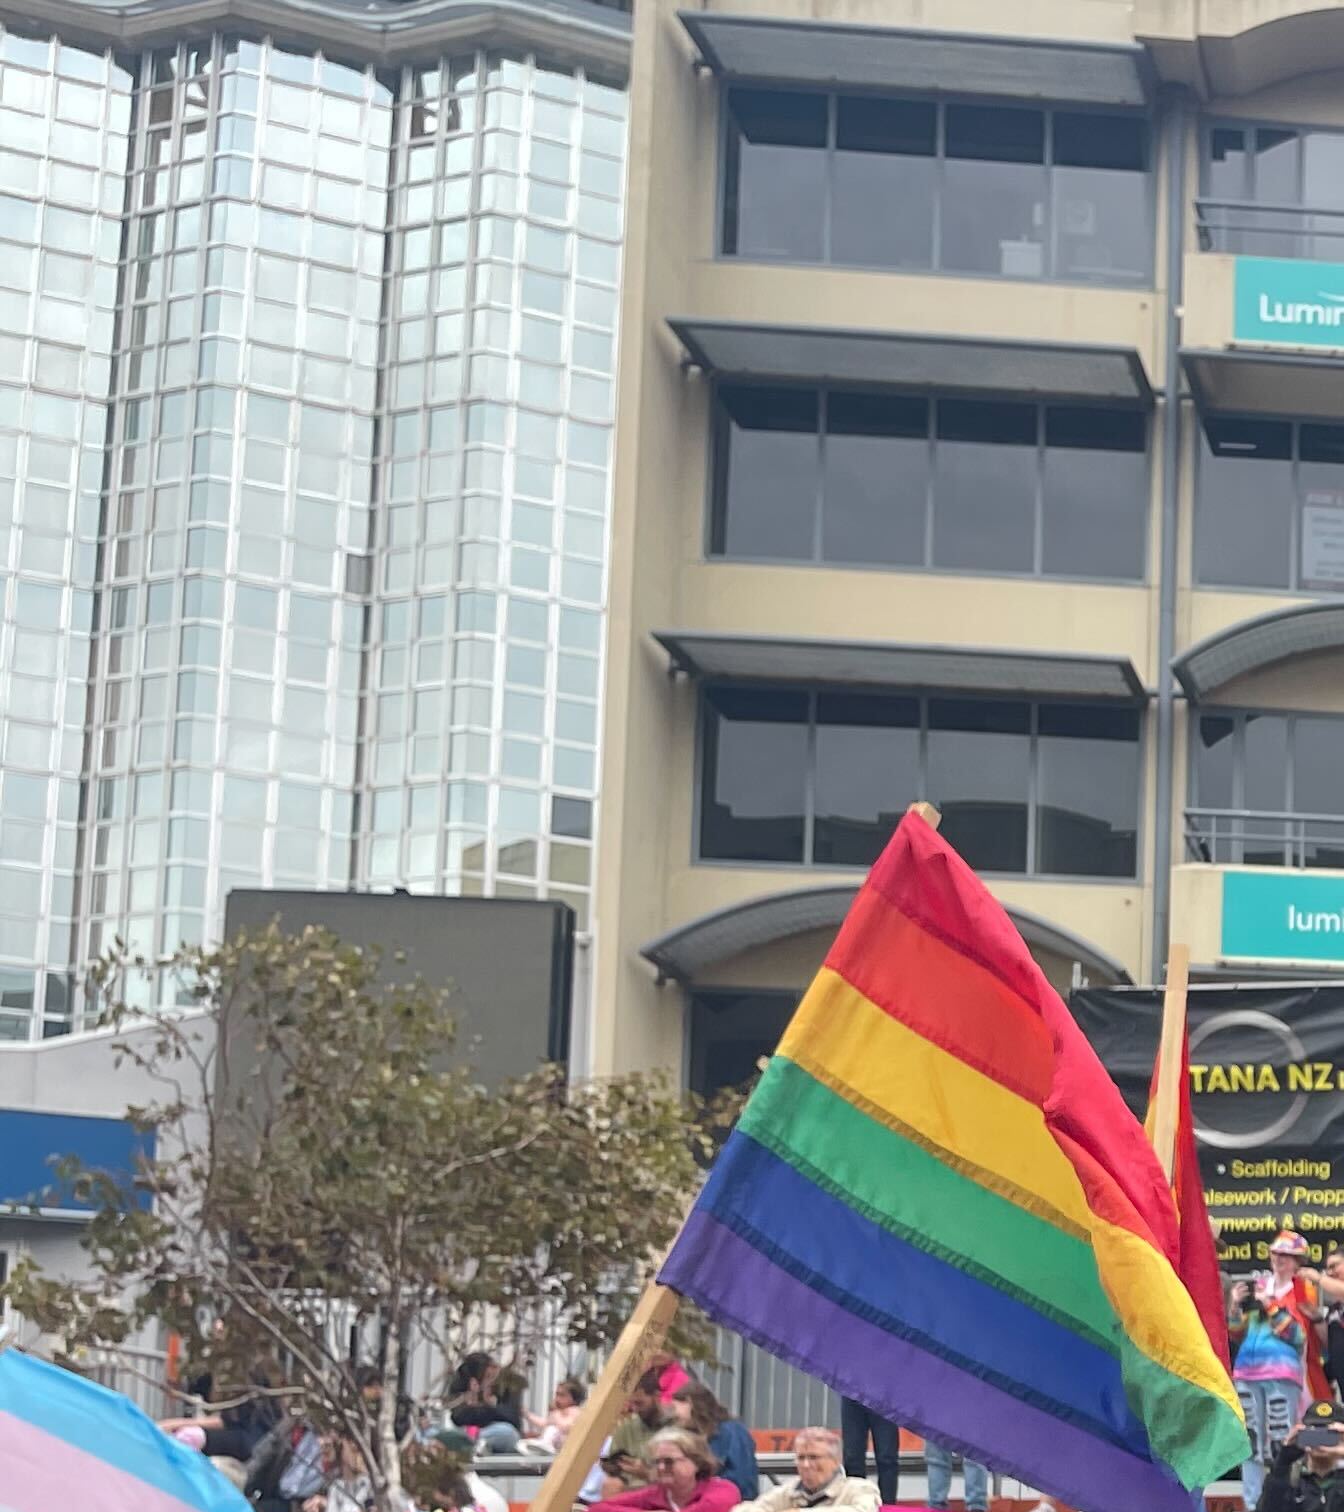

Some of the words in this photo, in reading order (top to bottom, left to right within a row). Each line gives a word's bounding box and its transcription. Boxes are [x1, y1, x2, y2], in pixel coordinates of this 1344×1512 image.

[1189, 1064, 1280, 1093] TANA
[1288, 1063, 1333, 1091] NZ
[1231, 1160, 1331, 1180] Scaffolding
[1204, 1188, 1276, 1206] alsework
